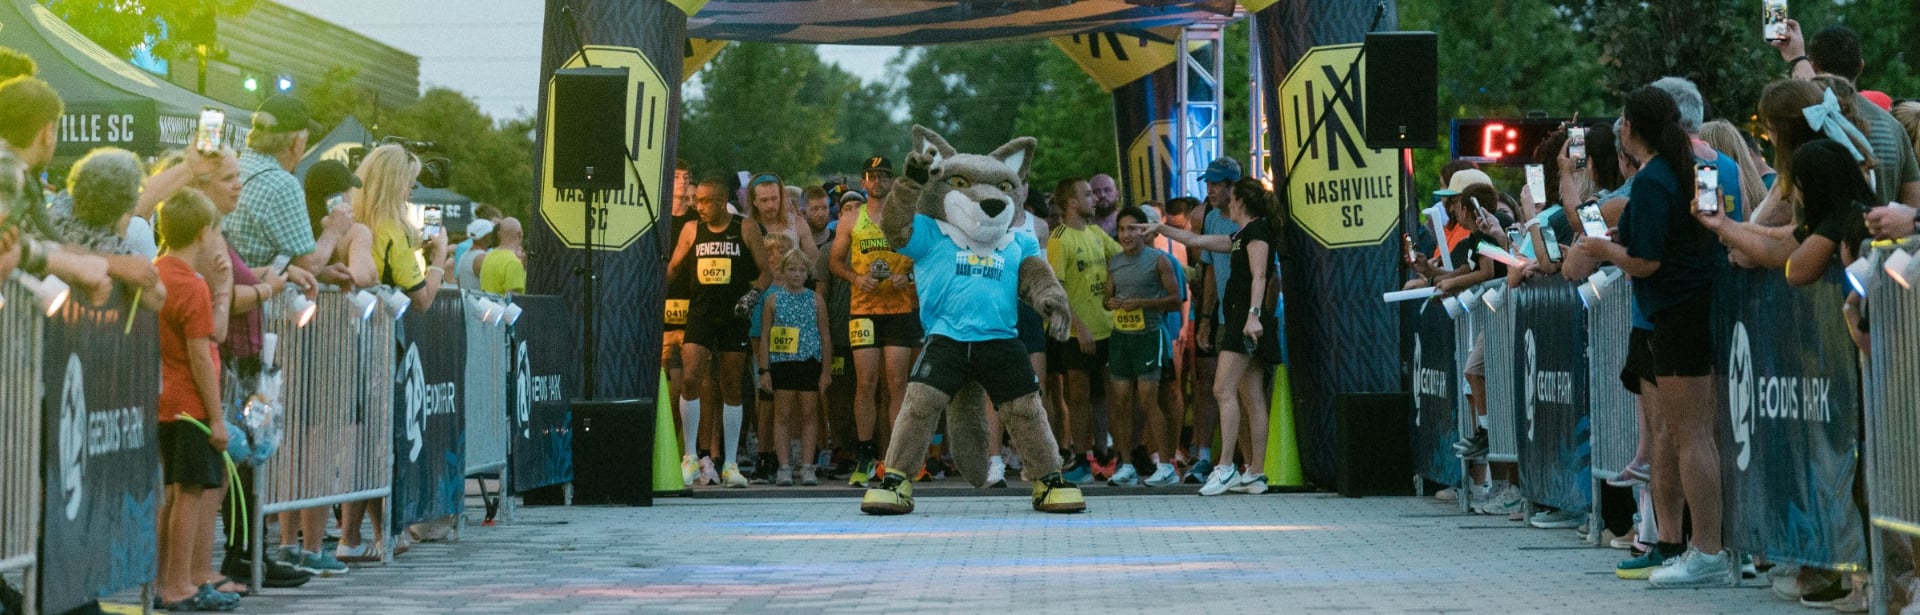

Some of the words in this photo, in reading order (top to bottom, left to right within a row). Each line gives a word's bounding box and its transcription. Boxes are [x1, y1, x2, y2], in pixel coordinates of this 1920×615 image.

[62, 114, 101, 142] ILLE
[108, 114, 134, 142] SC
[1305, 175, 1393, 205] NASHVILLE
[446, 204, 461, 218] SC
[588, 207, 608, 231] SC
[1342, 204, 1364, 228] SC
[696, 241, 740, 257] VENEZUELA
[860, 239, 888, 250] RUNNE
[702, 268, 726, 277] 0671
[1117, 314, 1141, 323] 0535
[774, 336, 794, 345] 0617
[1759, 376, 1799, 419] EODIS
